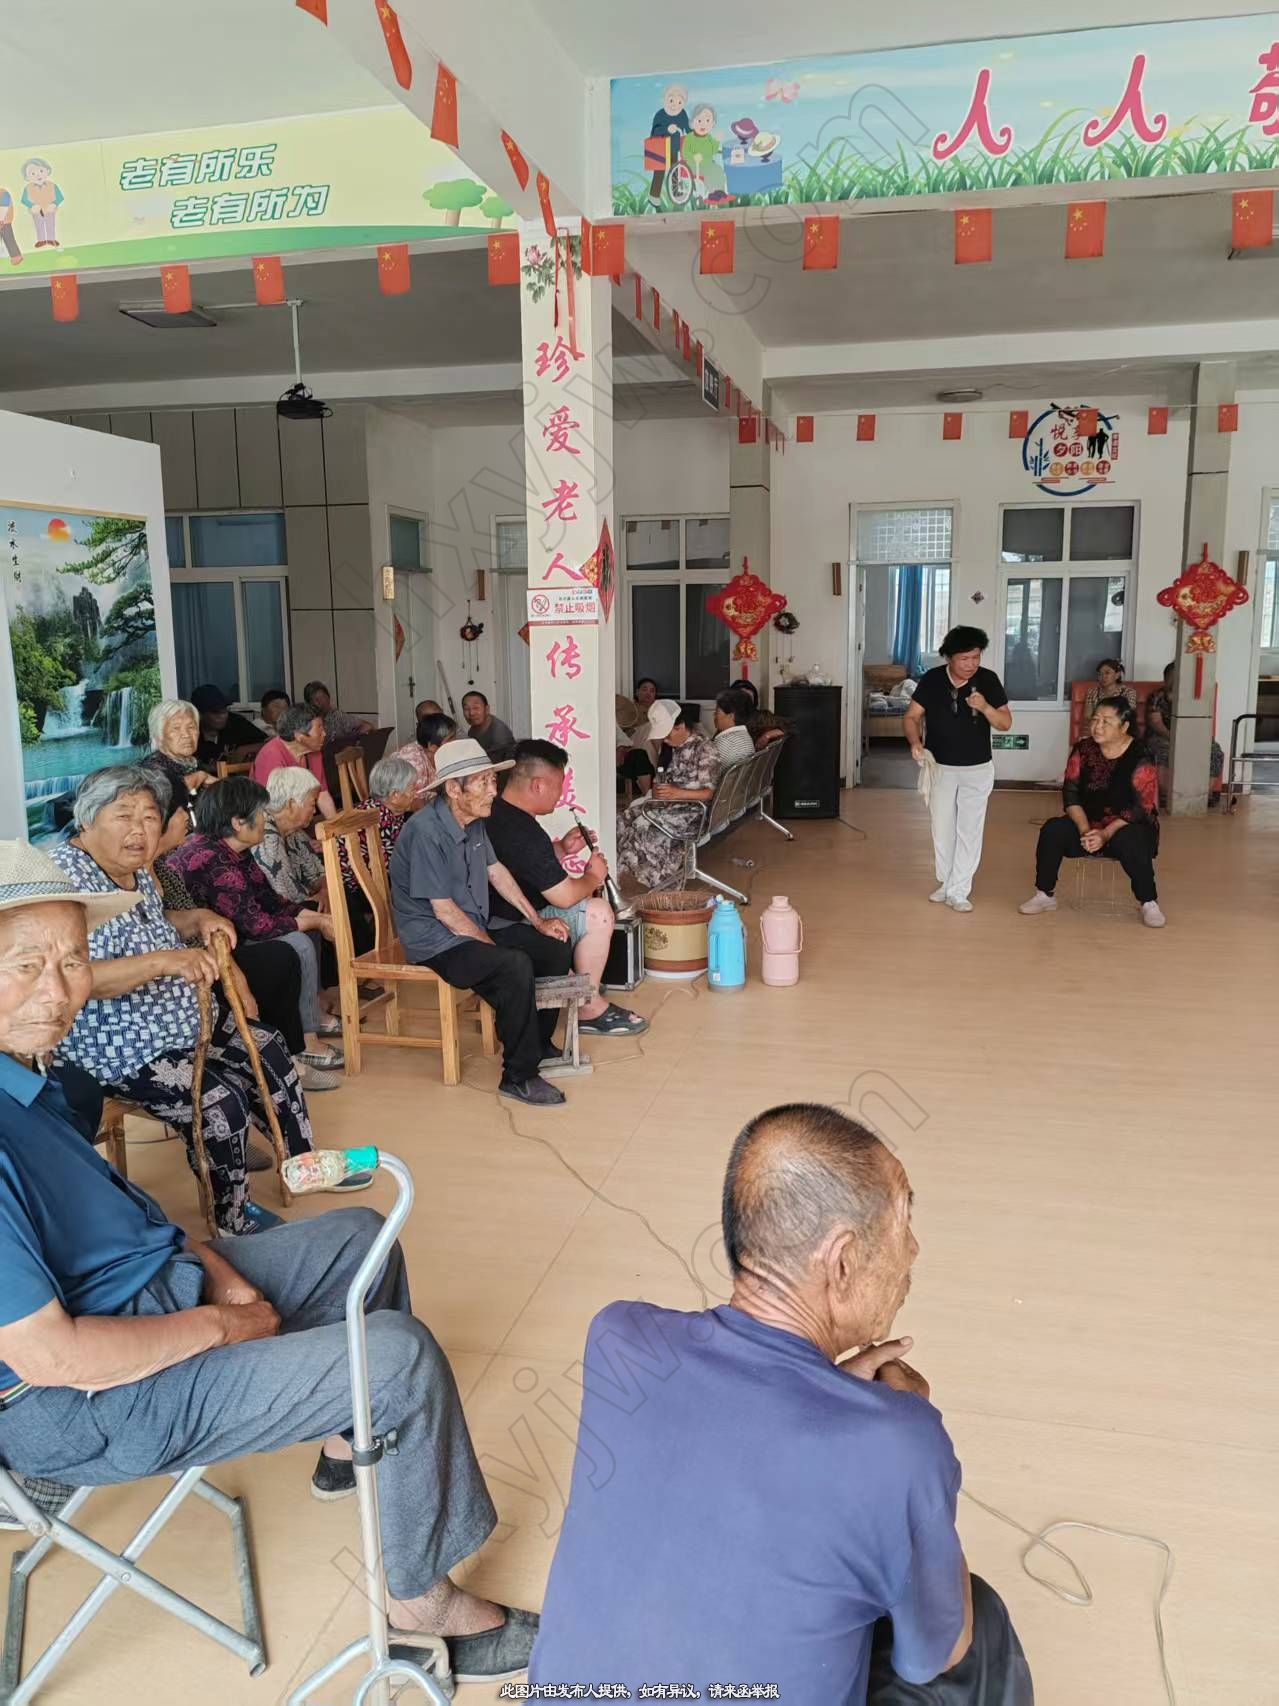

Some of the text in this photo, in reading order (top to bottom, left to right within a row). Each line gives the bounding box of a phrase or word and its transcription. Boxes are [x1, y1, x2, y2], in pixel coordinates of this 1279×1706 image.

[119, 144, 277, 190] 老有所乐
[171, 185, 330, 229] 老有所为
[535, 334, 585, 582] 珍爱老人
[554, 602, 596, 614] 禁止吸烟
